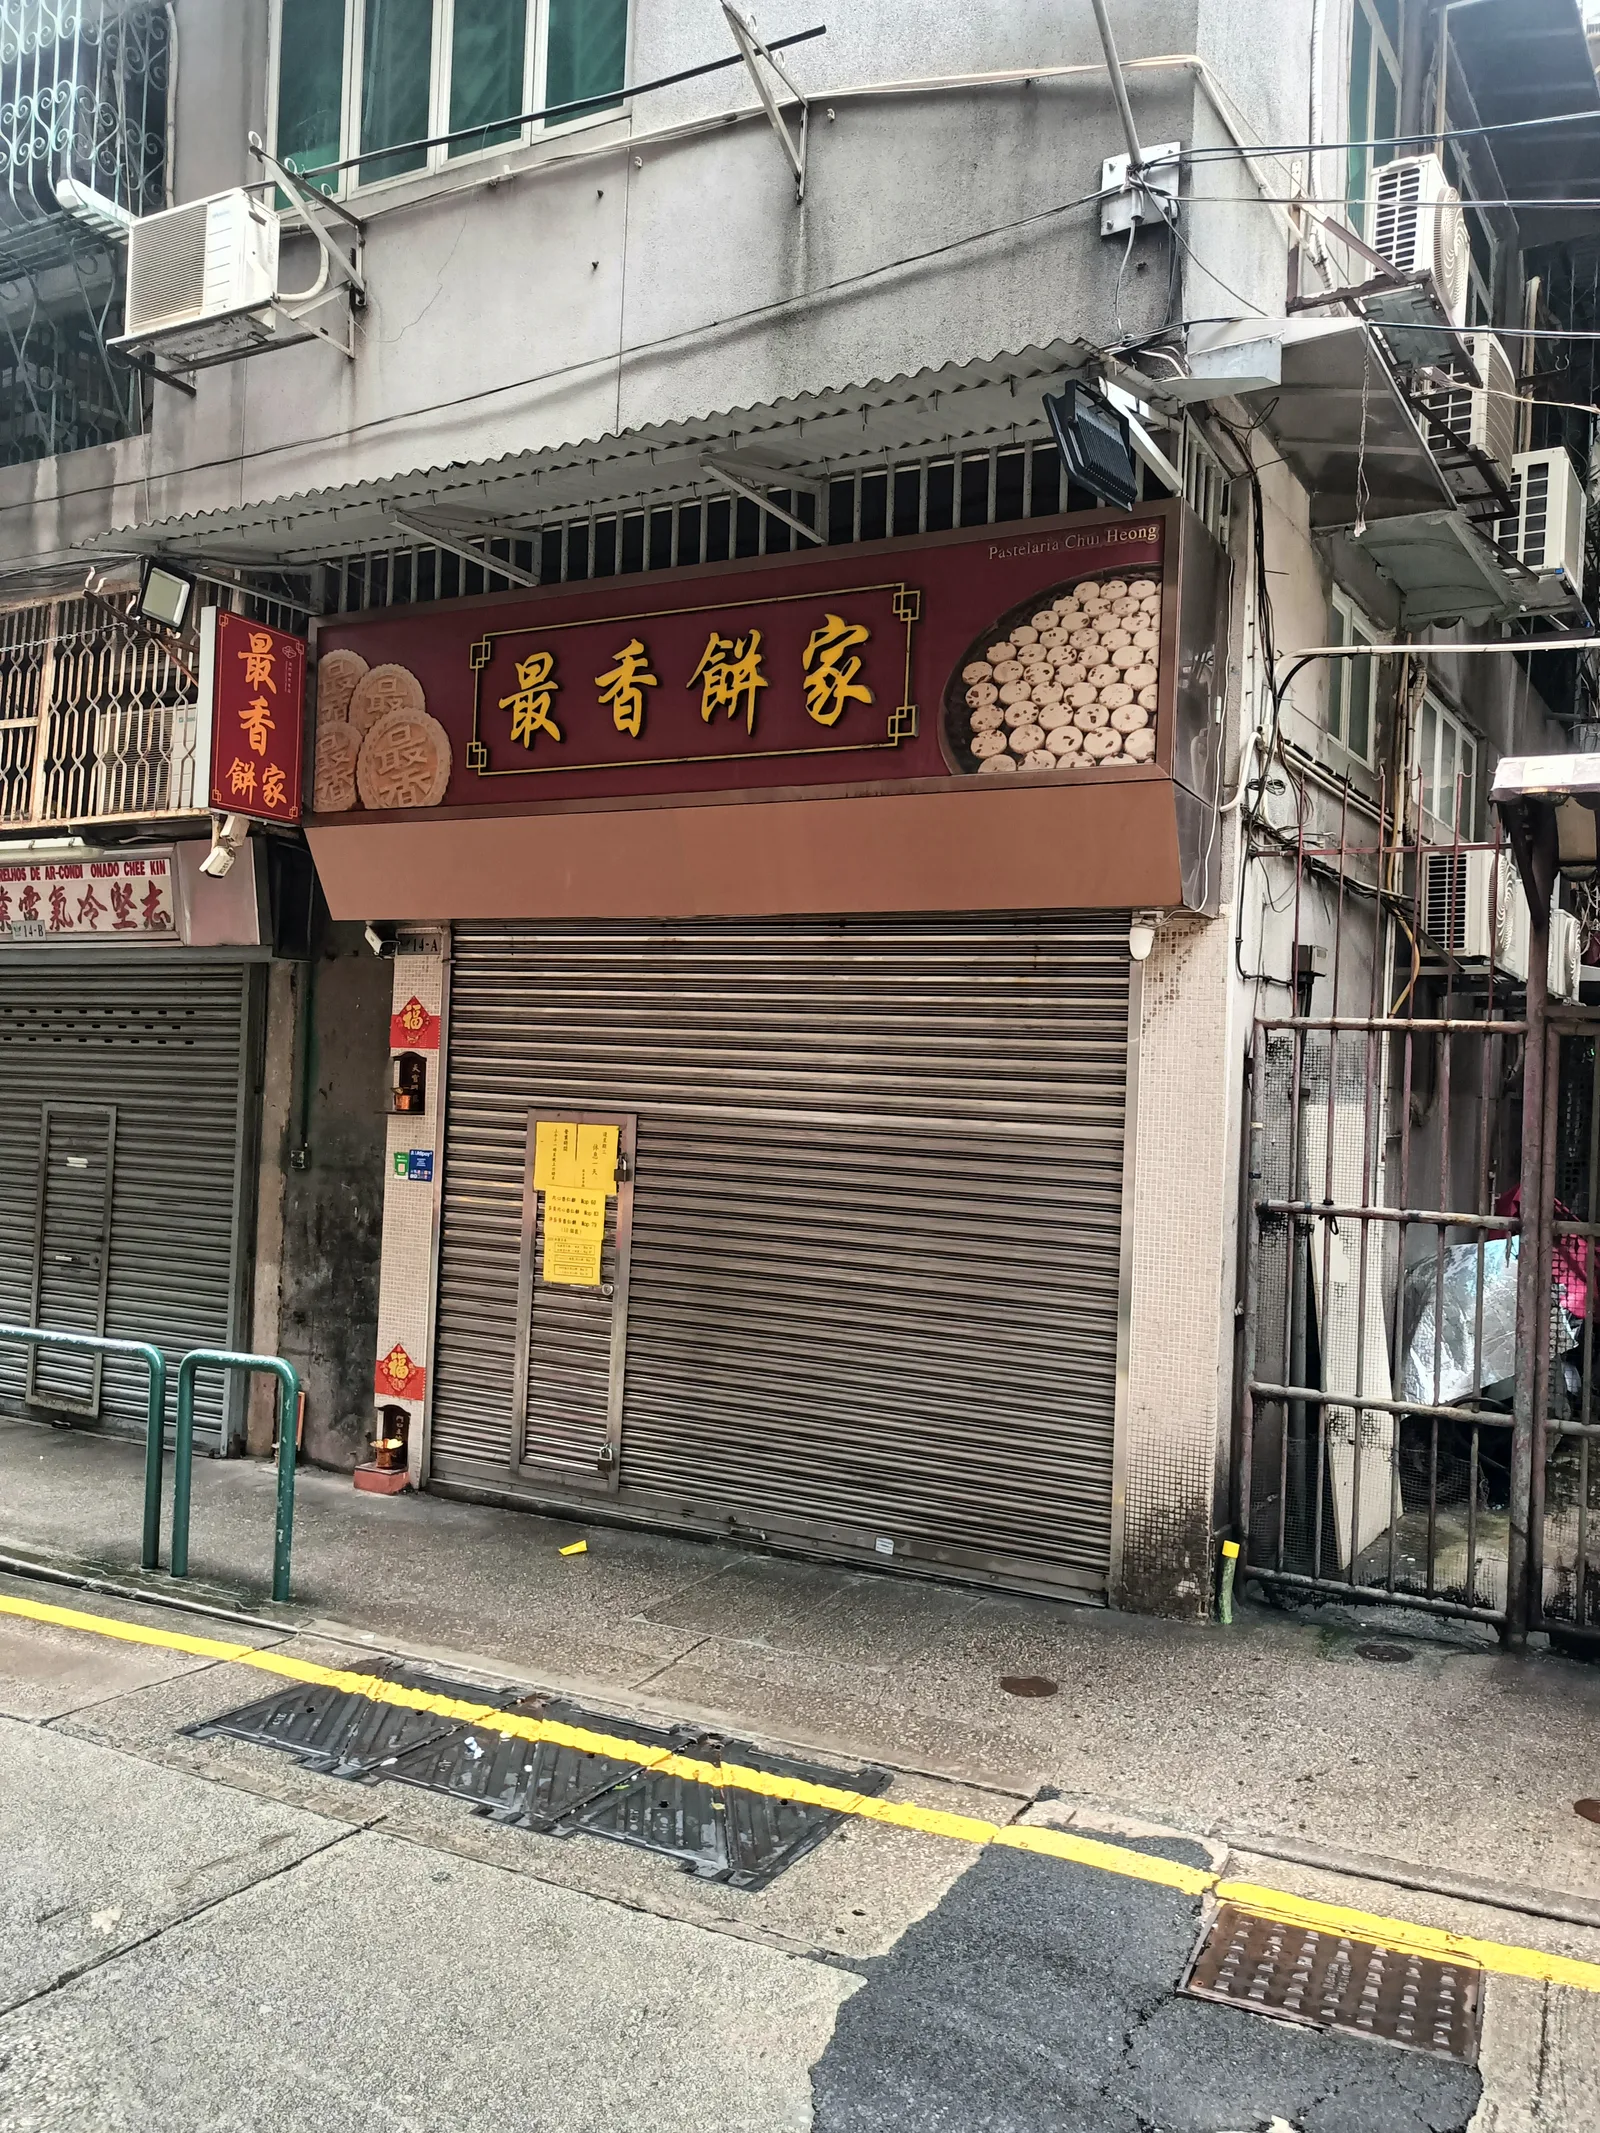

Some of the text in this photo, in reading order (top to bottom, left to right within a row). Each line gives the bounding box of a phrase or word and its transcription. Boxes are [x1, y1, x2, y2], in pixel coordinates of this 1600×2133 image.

[989, 540, 1059, 560] Pastelaria
[1106, 525, 1158, 544] Heong
[499, 613, 874, 750] 最香餅家
[30, 866, 41, 881] DE
[90, 862, 120, 878] ONADO
[123, 860, 146, 876] CHEE
[150, 859, 166, 875] KIN
[23, 924, 44, 938] 14-B
[413, 938, 438, 952] 14-A
[402, 1004, 423, 1030] 福
[388, 1352, 409, 1380] 福
